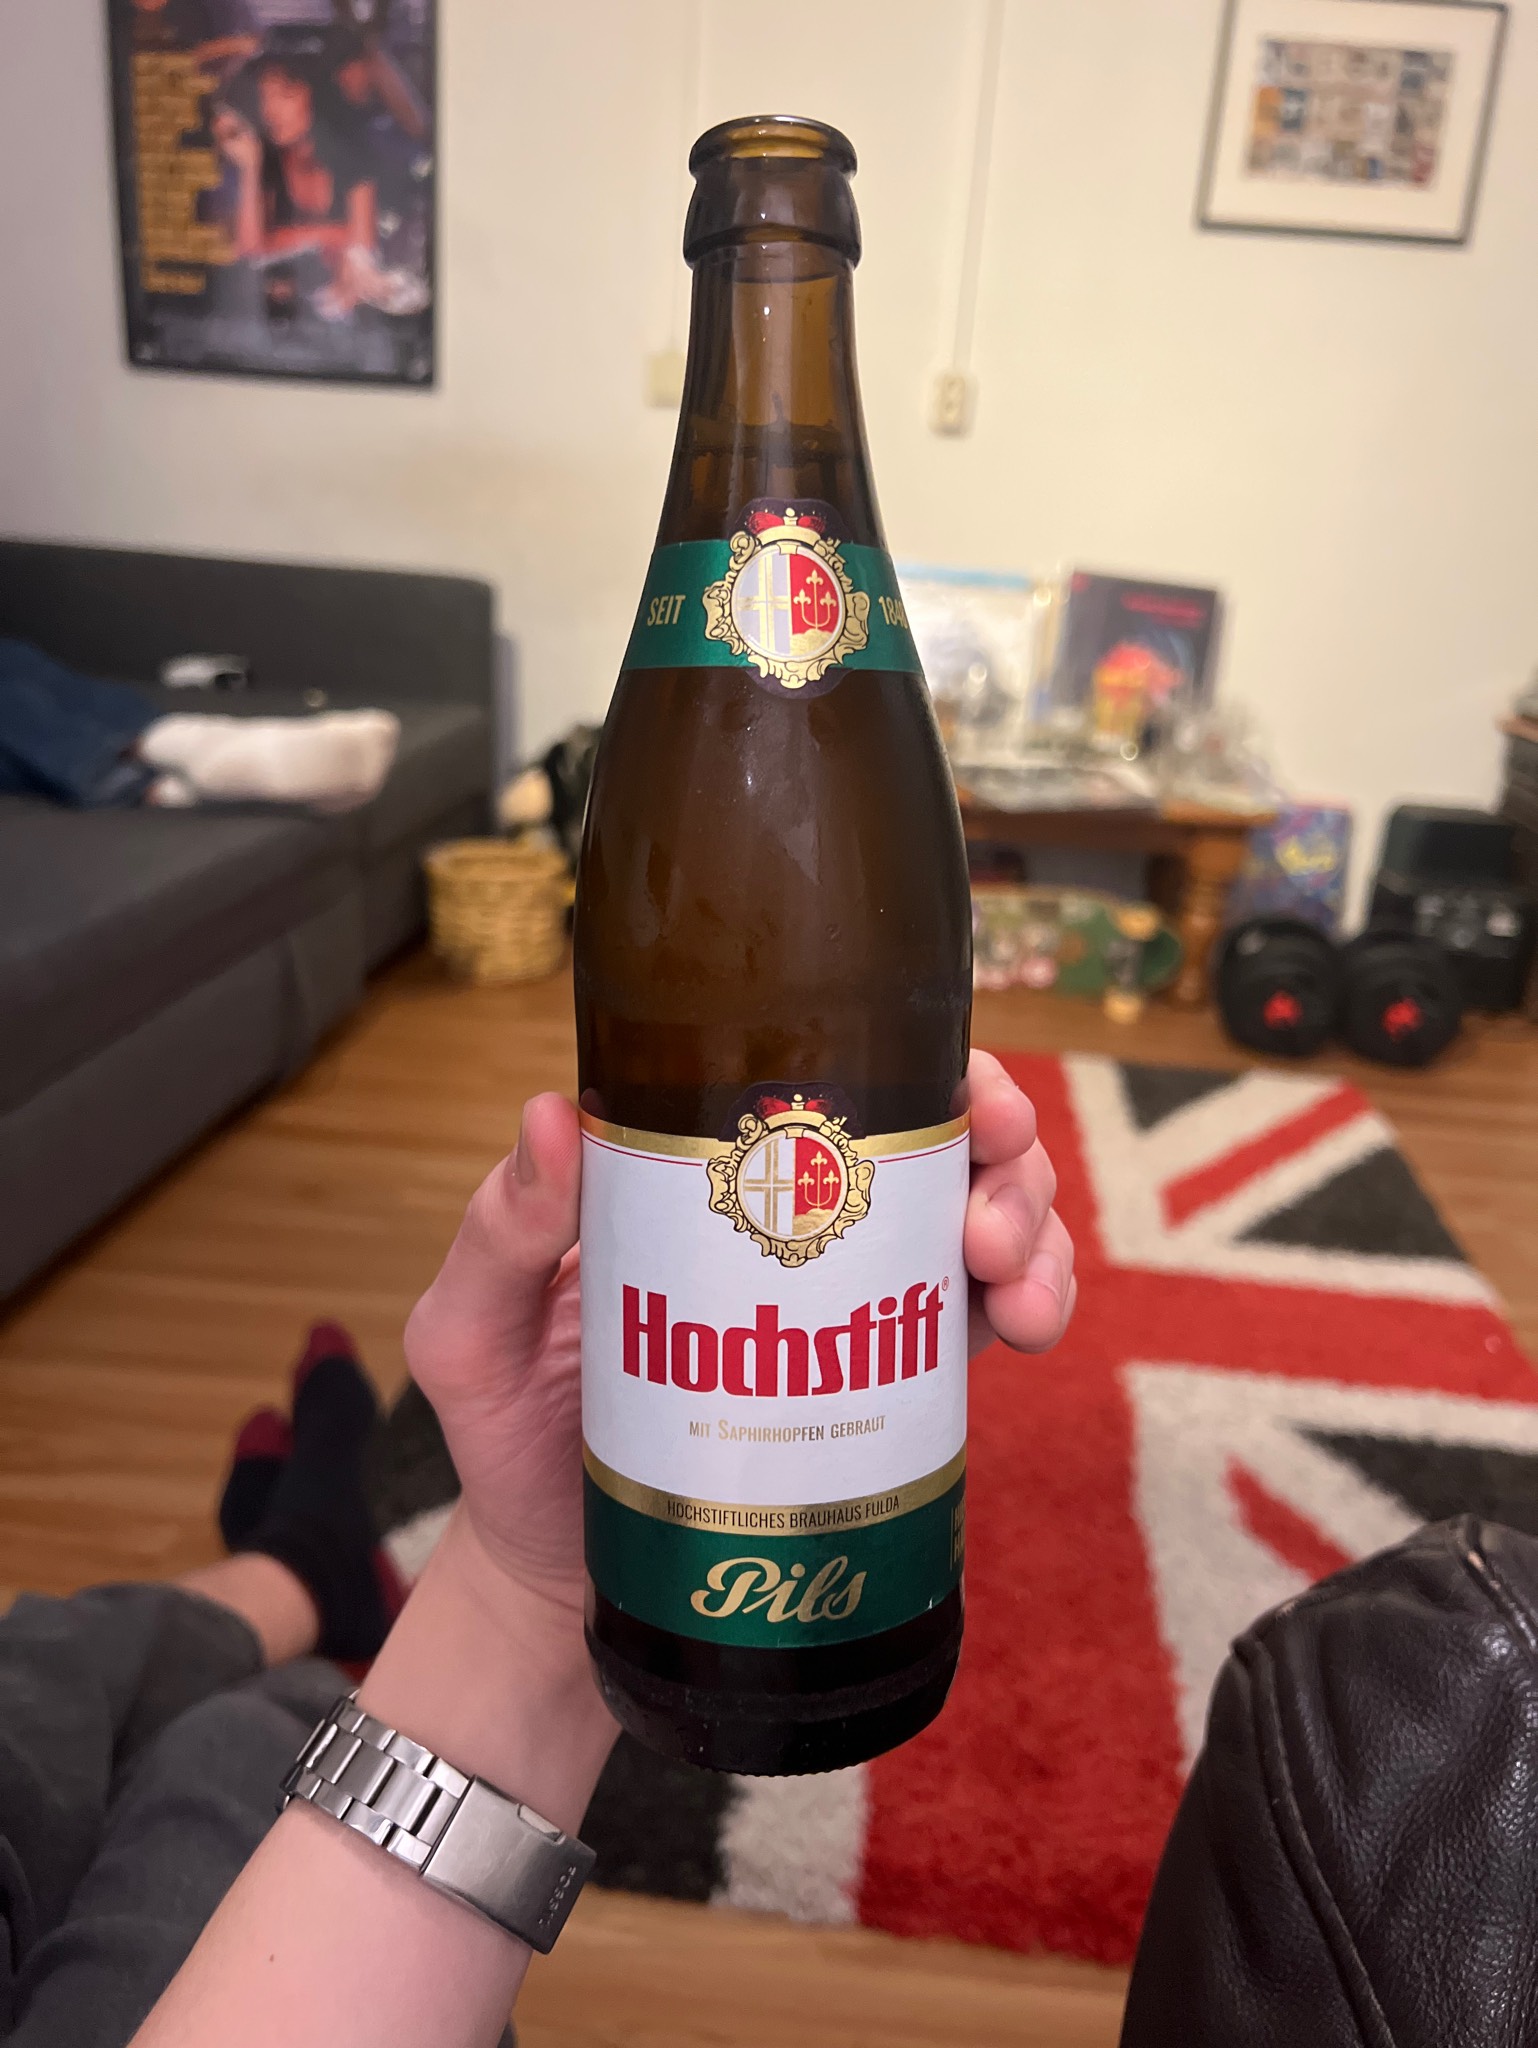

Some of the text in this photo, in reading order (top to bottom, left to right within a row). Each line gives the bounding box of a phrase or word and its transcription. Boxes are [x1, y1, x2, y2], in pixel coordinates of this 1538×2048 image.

[648, 594, 686, 627] SEIT
[689, 1421, 711, 1438] MIT
[830, 1415, 886, 1439] GEBRAUT
[667, 1496, 900, 1529] HOCHSTIFTLICHES BRAUHAUS FULDA
[690, 1555, 867, 1623] Pils
